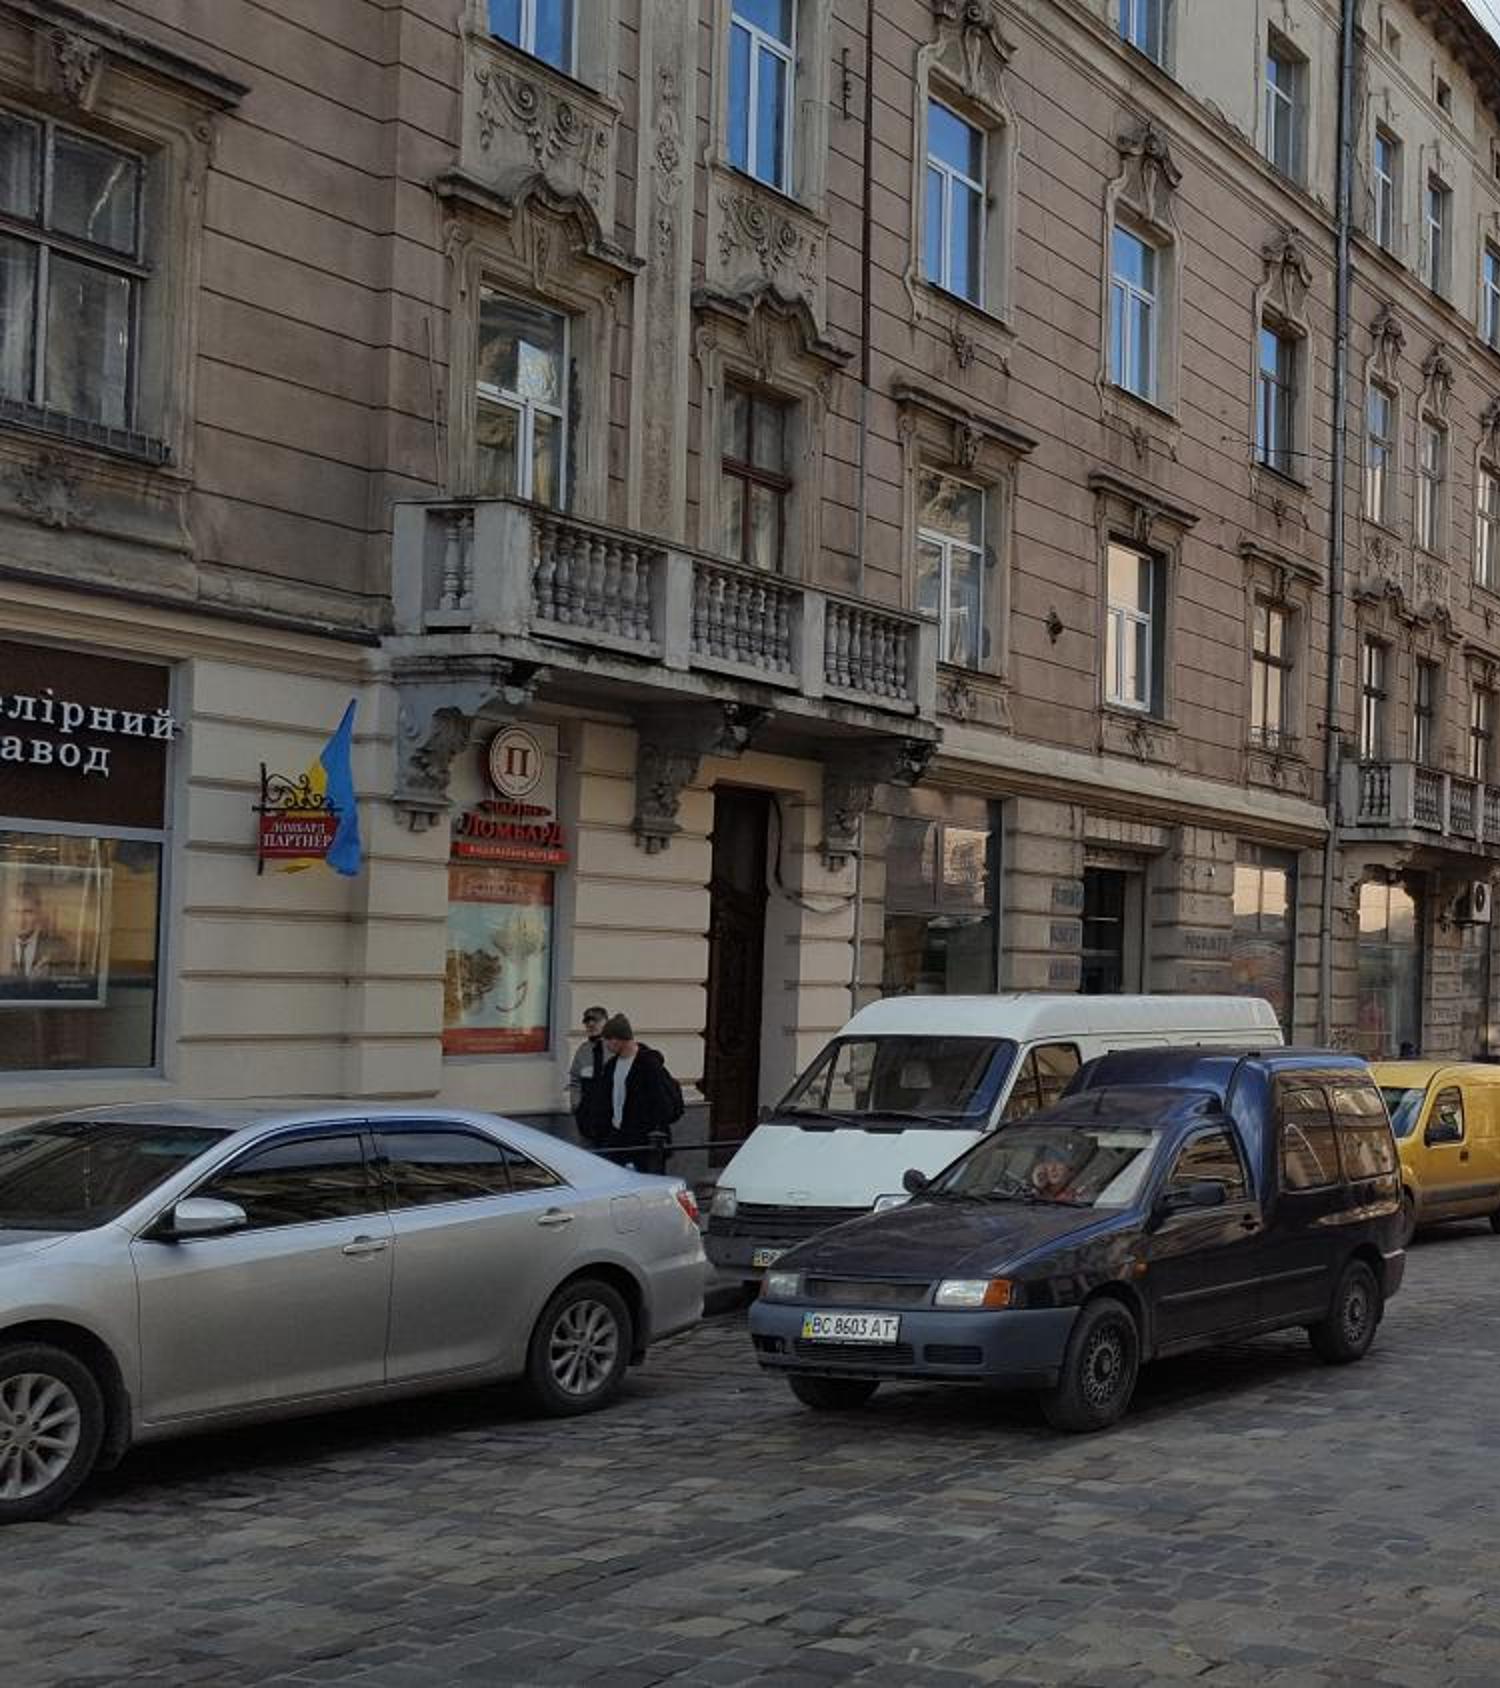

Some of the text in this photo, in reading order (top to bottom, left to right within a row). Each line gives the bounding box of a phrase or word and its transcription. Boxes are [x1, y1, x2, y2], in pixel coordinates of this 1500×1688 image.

[0, 688, 176, 741] лірний
[263, 833, 333, 848] ПАРТНЕР
[834, 1317, 867, 1335] 8603
